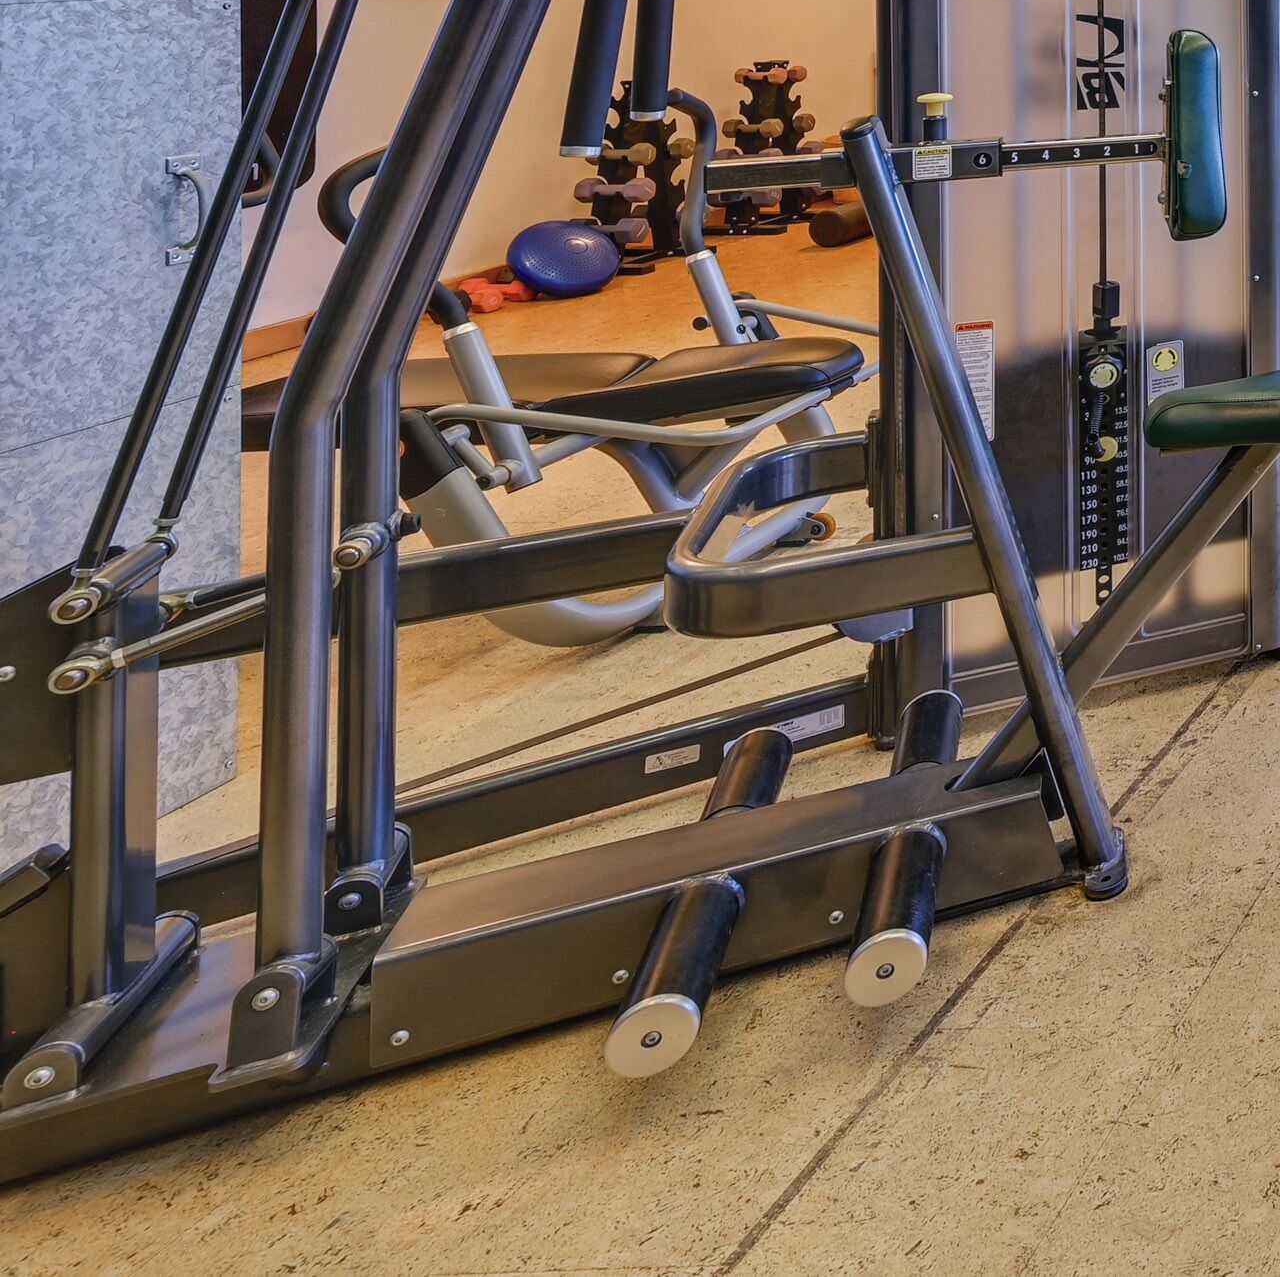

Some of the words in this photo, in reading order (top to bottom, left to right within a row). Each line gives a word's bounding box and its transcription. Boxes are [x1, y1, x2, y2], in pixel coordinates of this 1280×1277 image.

[978, 156, 987, 165] 6
[1011, 152, 1019, 163] 5
[1042, 150, 1050, 161] 4
[1073, 148, 1081, 159] 3
[1104, 146, 1112, 157] 2
[1134, 144, 1139, 155] 1
[1081, 470, 1097, 480] 110
[1081, 485, 1097, 495] 130
[1081, 500, 1097, 510] 150
[1081, 514, 1098, 525] 170
[1081, 529, 1097, 540] 190
[1081, 544, 1098, 555] 210
[1081, 558, 1098, 569] 230
